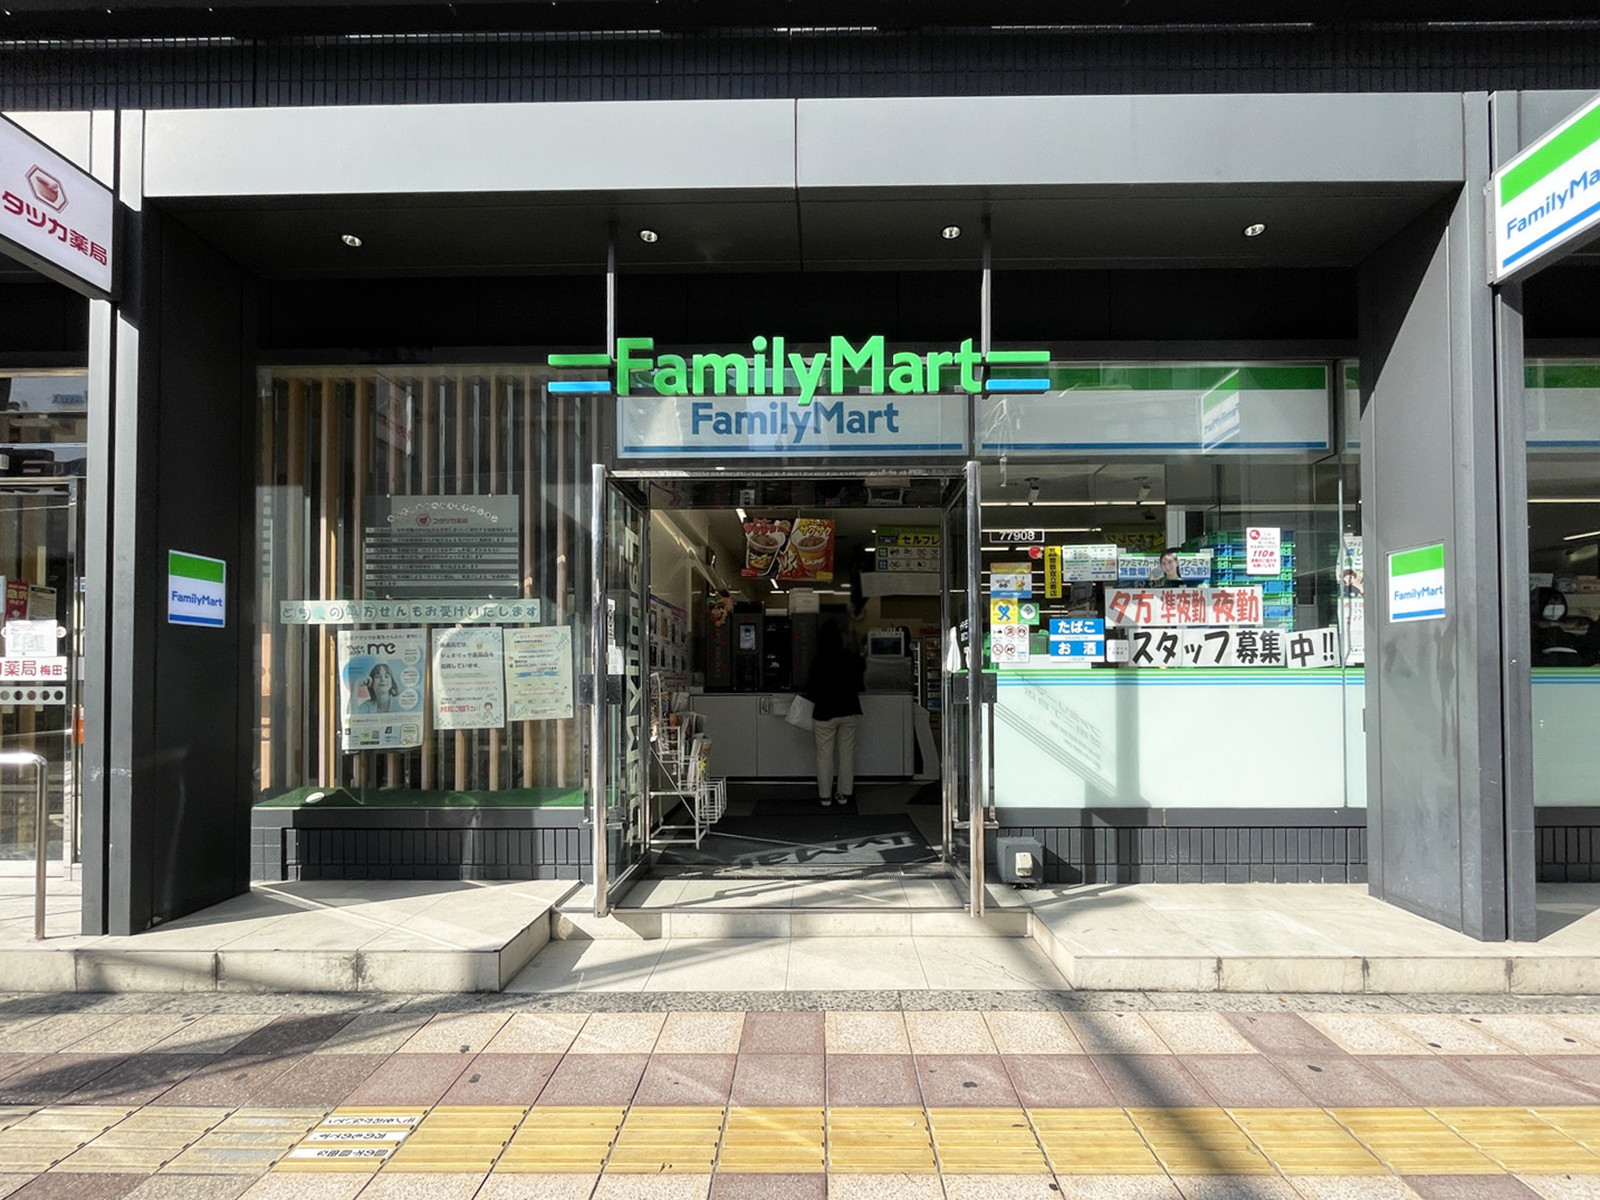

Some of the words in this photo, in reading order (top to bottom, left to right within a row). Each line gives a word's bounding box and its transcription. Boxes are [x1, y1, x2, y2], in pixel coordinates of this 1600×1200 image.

[2, 189, 108, 267] タツカ薬局
[616, 335, 981, 406] FamilyMart
[691, 401, 899, 444] FamilyMart
[999, 531, 1035, 541] 77908
[171, 590, 223, 608] FamilyMart
[1393, 584, 1444, 602] FamilyMart
[1109, 589, 1155, 624] 夕方
[1160, 589, 1207, 624] 準夜勤
[1211, 589, 1259, 623] 夜勤
[1057, 619, 1096, 634] たばこ
[367, 642, 396, 655] me
[0, 660, 37, 677] 薬局
[40, 664, 67, 676] 梅田
